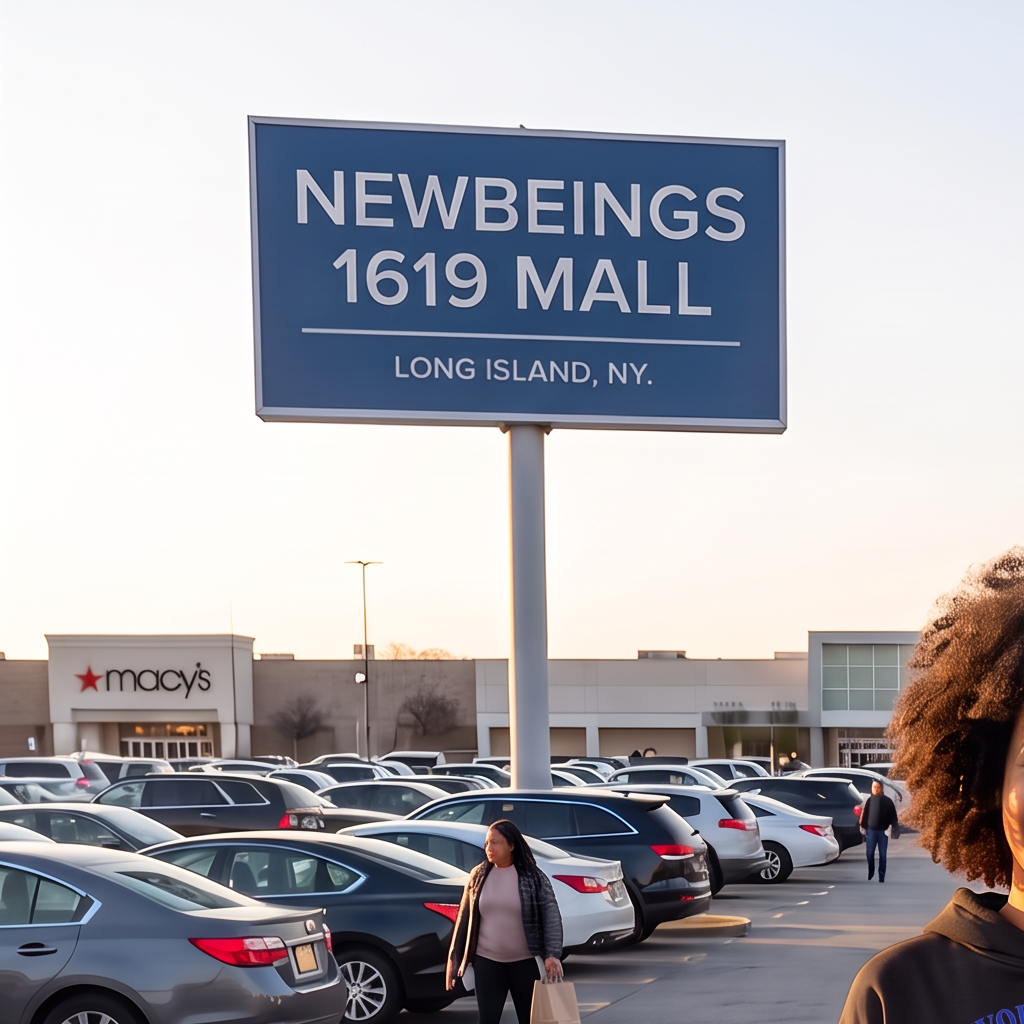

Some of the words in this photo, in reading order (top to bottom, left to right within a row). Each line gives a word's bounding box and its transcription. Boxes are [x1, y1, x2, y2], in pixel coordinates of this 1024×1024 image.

[296, 169, 746, 242] NEWBEINGS
[333, 249, 488, 309] 1619
[517, 256, 712, 317] MALL
[395, 355, 476, 380] LONG
[486, 358, 599, 388] ISLAND,
[608, 362, 654, 386] NY.
[106, 662, 211, 699] macy's
